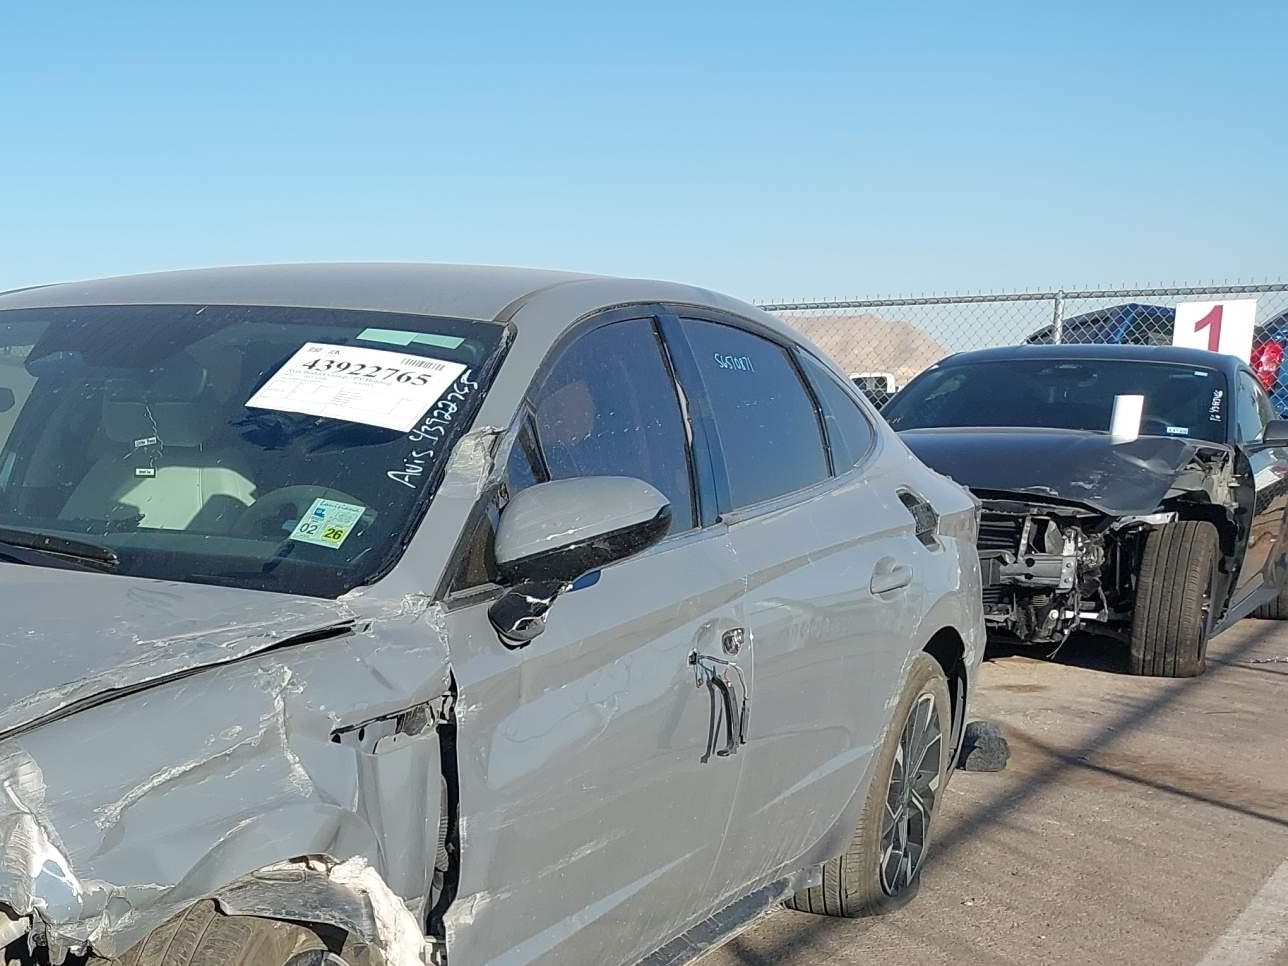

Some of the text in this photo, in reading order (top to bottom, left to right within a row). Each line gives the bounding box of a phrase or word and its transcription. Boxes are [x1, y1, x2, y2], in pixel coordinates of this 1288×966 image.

[1194, 305, 1223, 352] 1
[302, 357, 432, 387] 43922765
[299, 522, 343, 540] 02 26
